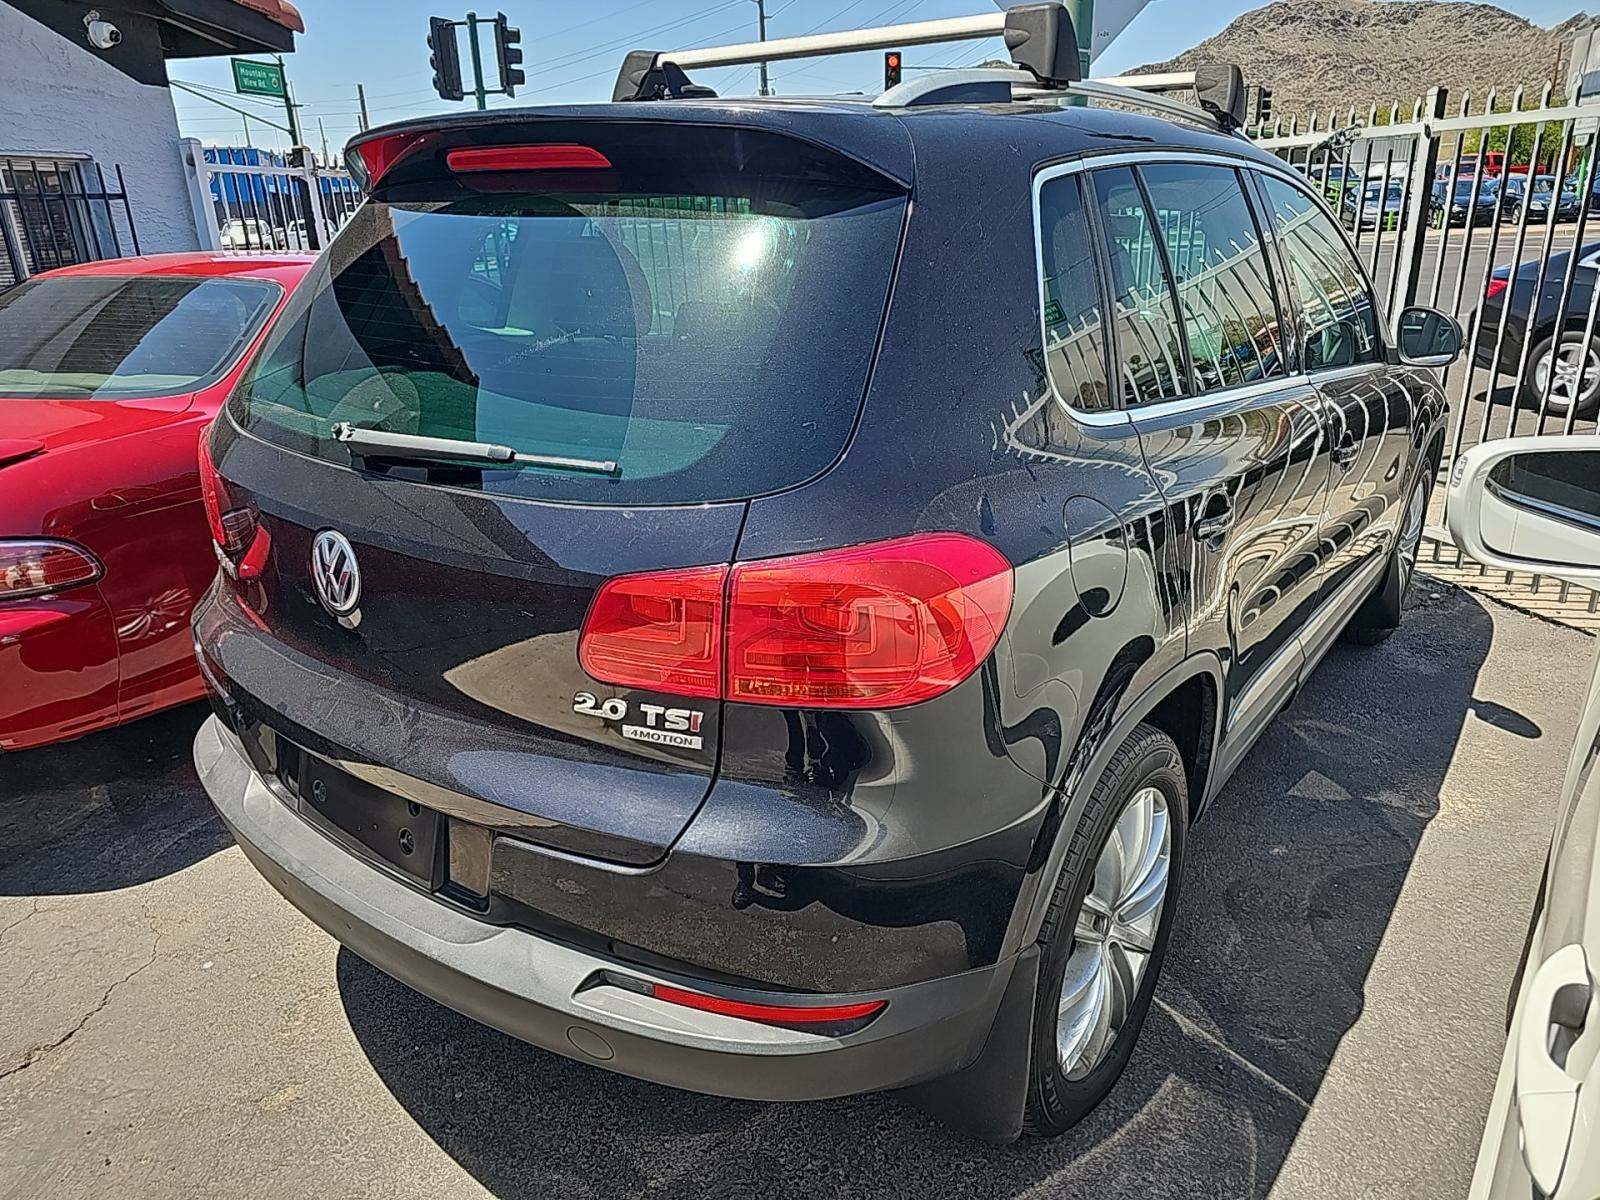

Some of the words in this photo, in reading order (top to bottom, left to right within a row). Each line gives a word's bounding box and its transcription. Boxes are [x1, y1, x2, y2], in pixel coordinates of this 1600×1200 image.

[240, 67, 267, 79] Mountain
[243, 78, 257, 88] View
[573, 691, 627, 721] 2.0
[640, 703, 704, 732] TSI
[629, 728, 693, 747] 4MOTION
